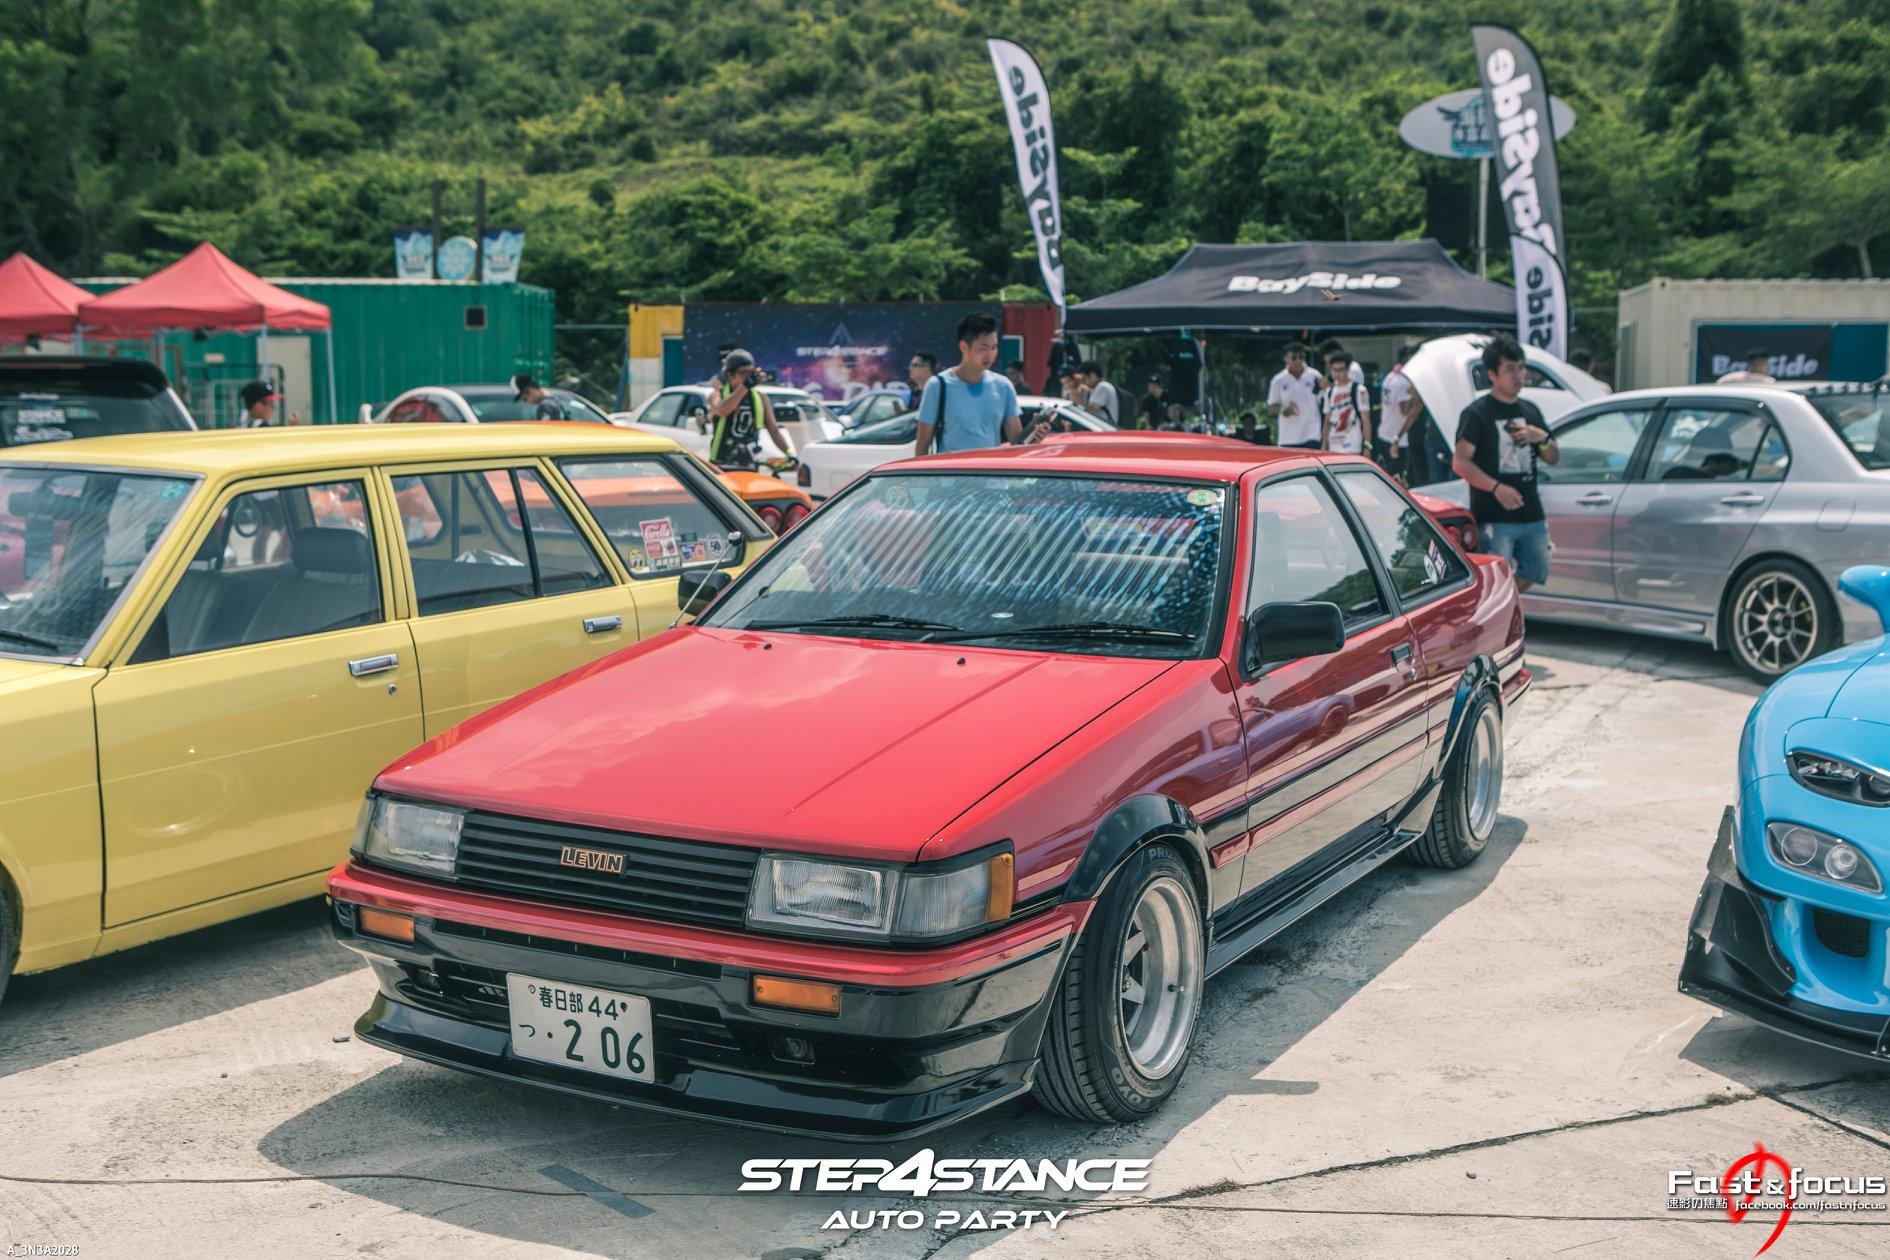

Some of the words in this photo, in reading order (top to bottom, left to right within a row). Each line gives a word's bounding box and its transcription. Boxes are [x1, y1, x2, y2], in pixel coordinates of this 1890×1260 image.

[1228, 272, 1401, 295] BaySide
[1712, 354, 1819, 377] BaSide
[561, 846, 623, 873] LEVIN
[539, 986, 583, 1013] 春日部
[588, 996, 618, 1020] 44
